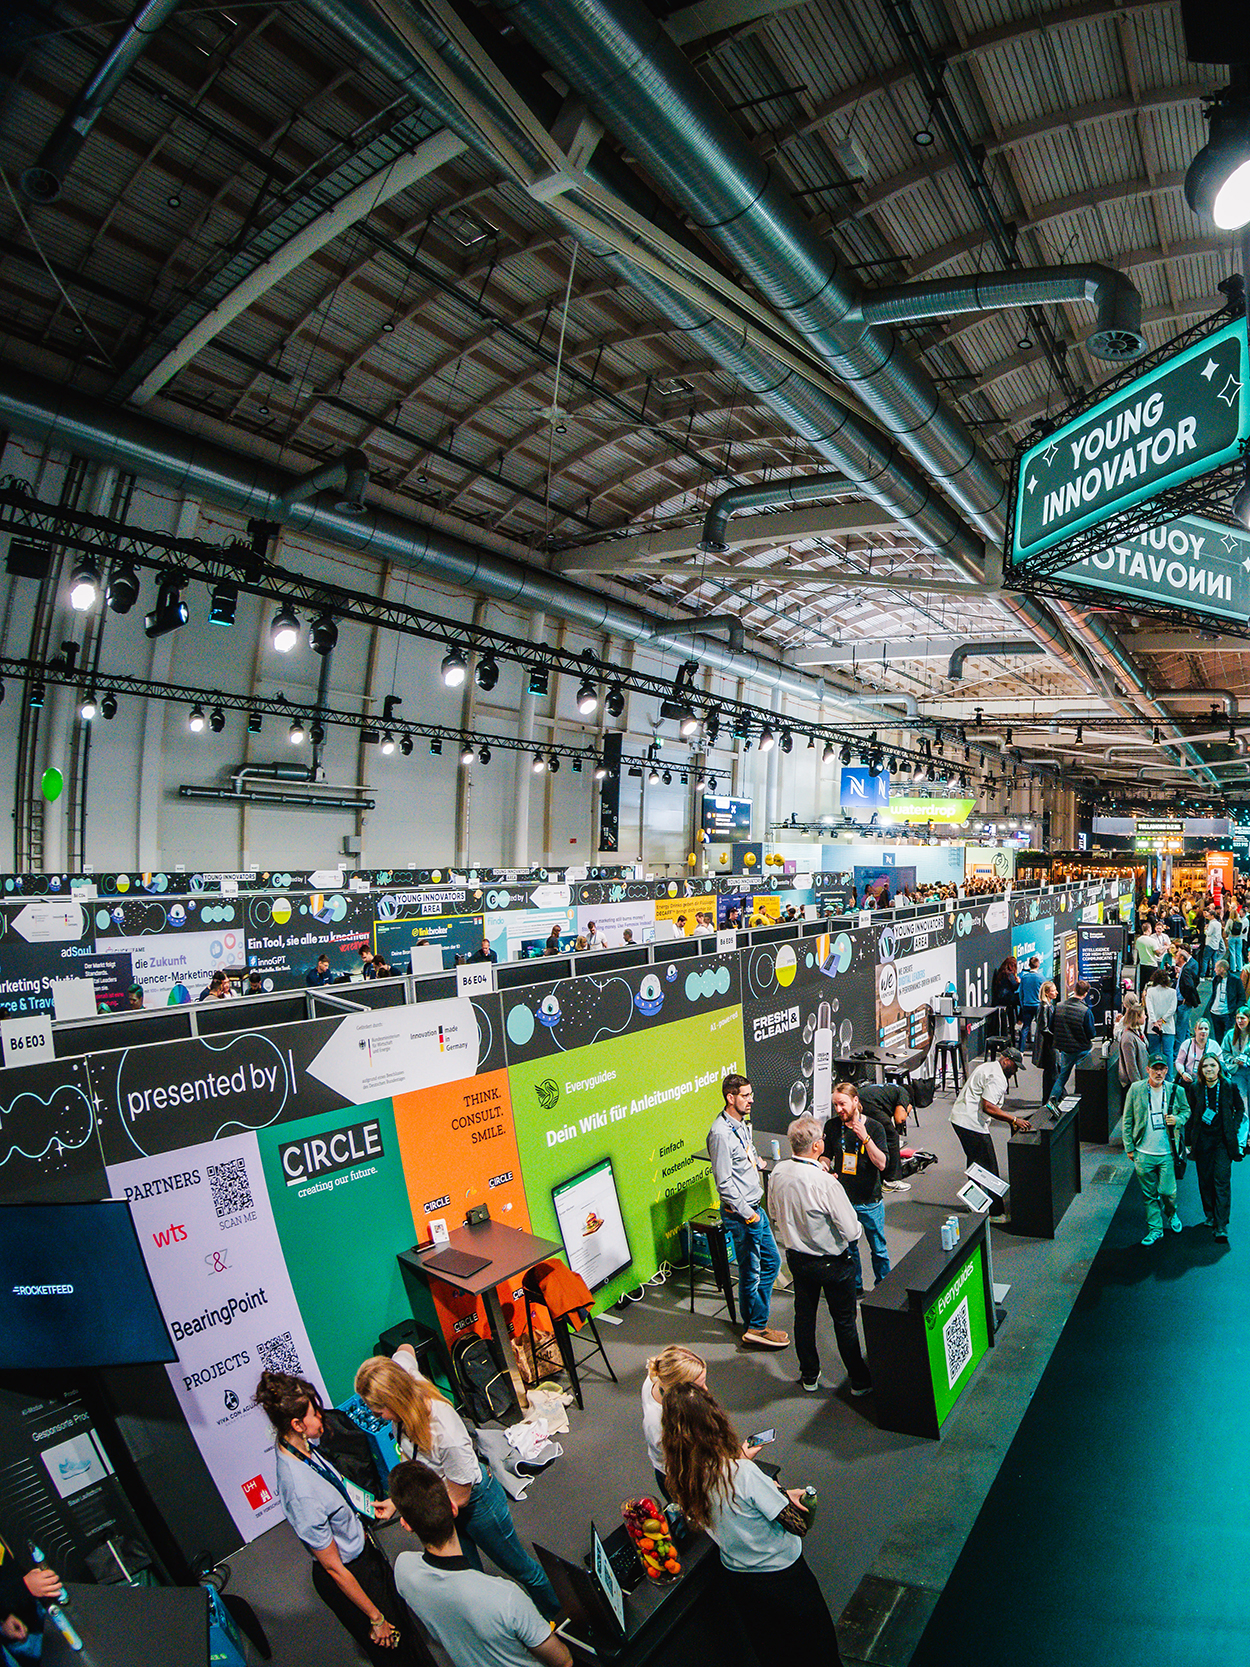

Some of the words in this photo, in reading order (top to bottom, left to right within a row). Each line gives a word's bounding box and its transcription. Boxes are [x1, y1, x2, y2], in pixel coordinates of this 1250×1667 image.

[1069, 391, 1166, 472] YOUNG
[1041, 416, 1198, 526] INNOVATOR
[890, 803, 956, 817] waterdrop
[397, 893, 422, 904] YOUNG
[423, 892, 465, 902] INNOVATORS
[423, 905, 441, 913] AREA
[418, 926, 448, 936] linkbroker
[894, 923, 915, 938] YOUNG
[915, 917, 944, 932] INNOVATORS
[61, 945, 92, 958] adSoul
[248, 938, 262, 950] Ein
[263, 935, 285, 949] Tool,
[287, 934, 299, 946] sie
[300, 933, 318, 944] alle
[318, 934, 329, 943] zu
[915, 936, 928, 948] AREA
[135, 959, 148, 969] die
[149, 955, 187, 968] Zukunft
[258, 955, 286, 967] innoGPT
[463, 975, 473, 987] B6
[474, 974, 487, 986] E04
[965, 962, 988, 1007] hi!
[710, 1011, 739, 1032] AI-powered
[753, 1009, 788, 1031] FRESH
[791, 1012, 798, 1024] &
[410, 1030, 438, 1040] Innovation
[754, 1021, 790, 1042] CLEAN
[10, 1037, 24, 1051] B6
[26, 1034, 45, 1049] E03
[446, 1042, 468, 1052] Germany
[565, 1069, 617, 1094] Everyguides
[127, 1071, 247, 1121] presented
[250, 1063, 278, 1093] by
[463, 1088, 501, 1108] THINK.
[546, 1123, 578, 1148] Dein
[579, 1110, 608, 1135] Wiki
[609, 1104, 628, 1124] für
[630, 1080, 693, 1116] Anleitungen
[694, 1070, 720, 1094] jeder
[720, 1061, 738, 1080] Art!
[451, 1106, 504, 1131] CONSULT.
[471, 1125, 506, 1144] SMILE.
[283, 1123, 381, 1182] CIRCLE
[659, 1139, 685, 1157] Einfach
[662, 1156, 695, 1178] Kostenlos
[124, 1169, 202, 1202] PARTNERS
[298, 1177, 333, 1199] creating
[334, 1174, 349, 1188] our
[350, 1165, 378, 1182] future.
[489, 1172, 513, 1188] CIRCLE
[665, 1171, 704, 1198] On-Demand
[424, 1195, 451, 1213] CIRCLE
[219, 1214, 243, 1231] SCAN
[243, 1211, 257, 1224] ME
[152, 1223, 188, 1249] wts
[19, 1283, 74, 1296] ROCKETFEED
[938, 1260, 974, 1315] Everyguides
[170, 1287, 269, 1342] BearingPoint
[453, 1313, 479, 1332] CIRCLE
[182, 1350, 251, 1391] PROJECTS
[216, 1417, 230, 1426] VIVA
[229, 1410, 242, 1419] CON
